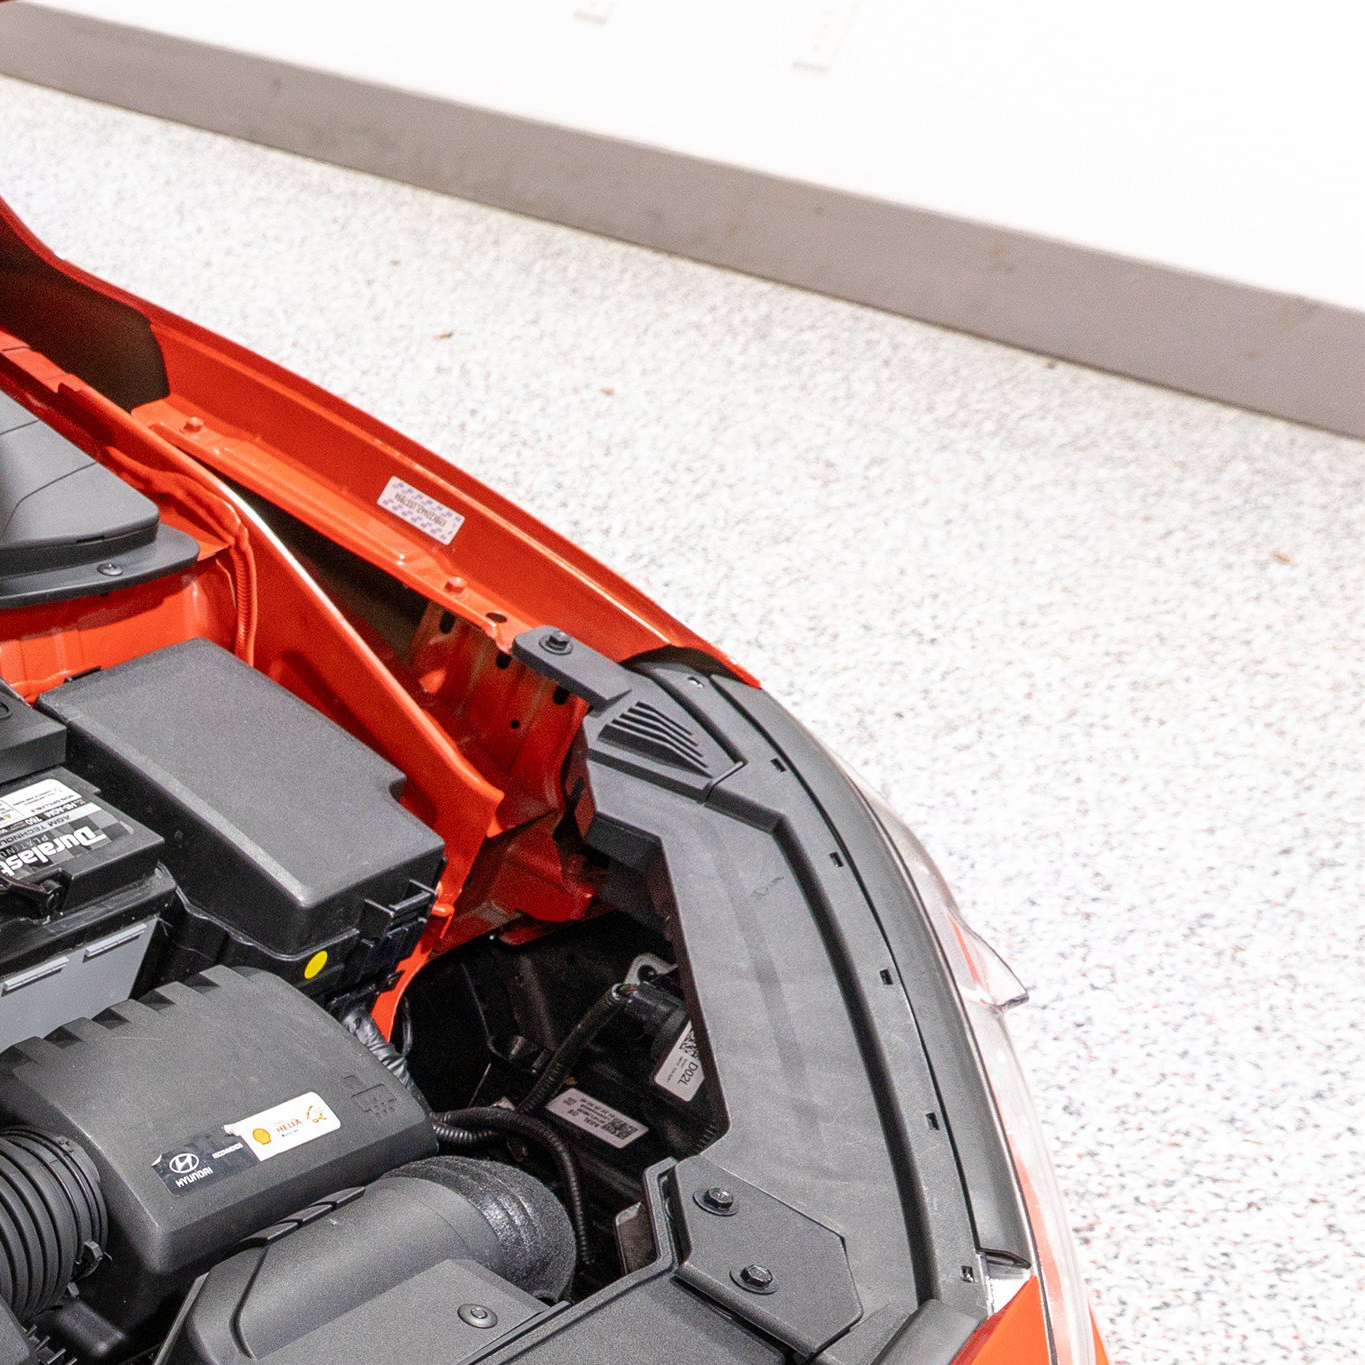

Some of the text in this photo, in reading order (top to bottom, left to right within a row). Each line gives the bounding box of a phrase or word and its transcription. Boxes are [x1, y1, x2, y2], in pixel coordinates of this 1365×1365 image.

[45, 814, 73, 827] AGM
[676, 1059, 698, 1090] D02L
[174, 1165, 214, 1187] HYUNDAI
[274, 1116, 303, 1133] HELIX
